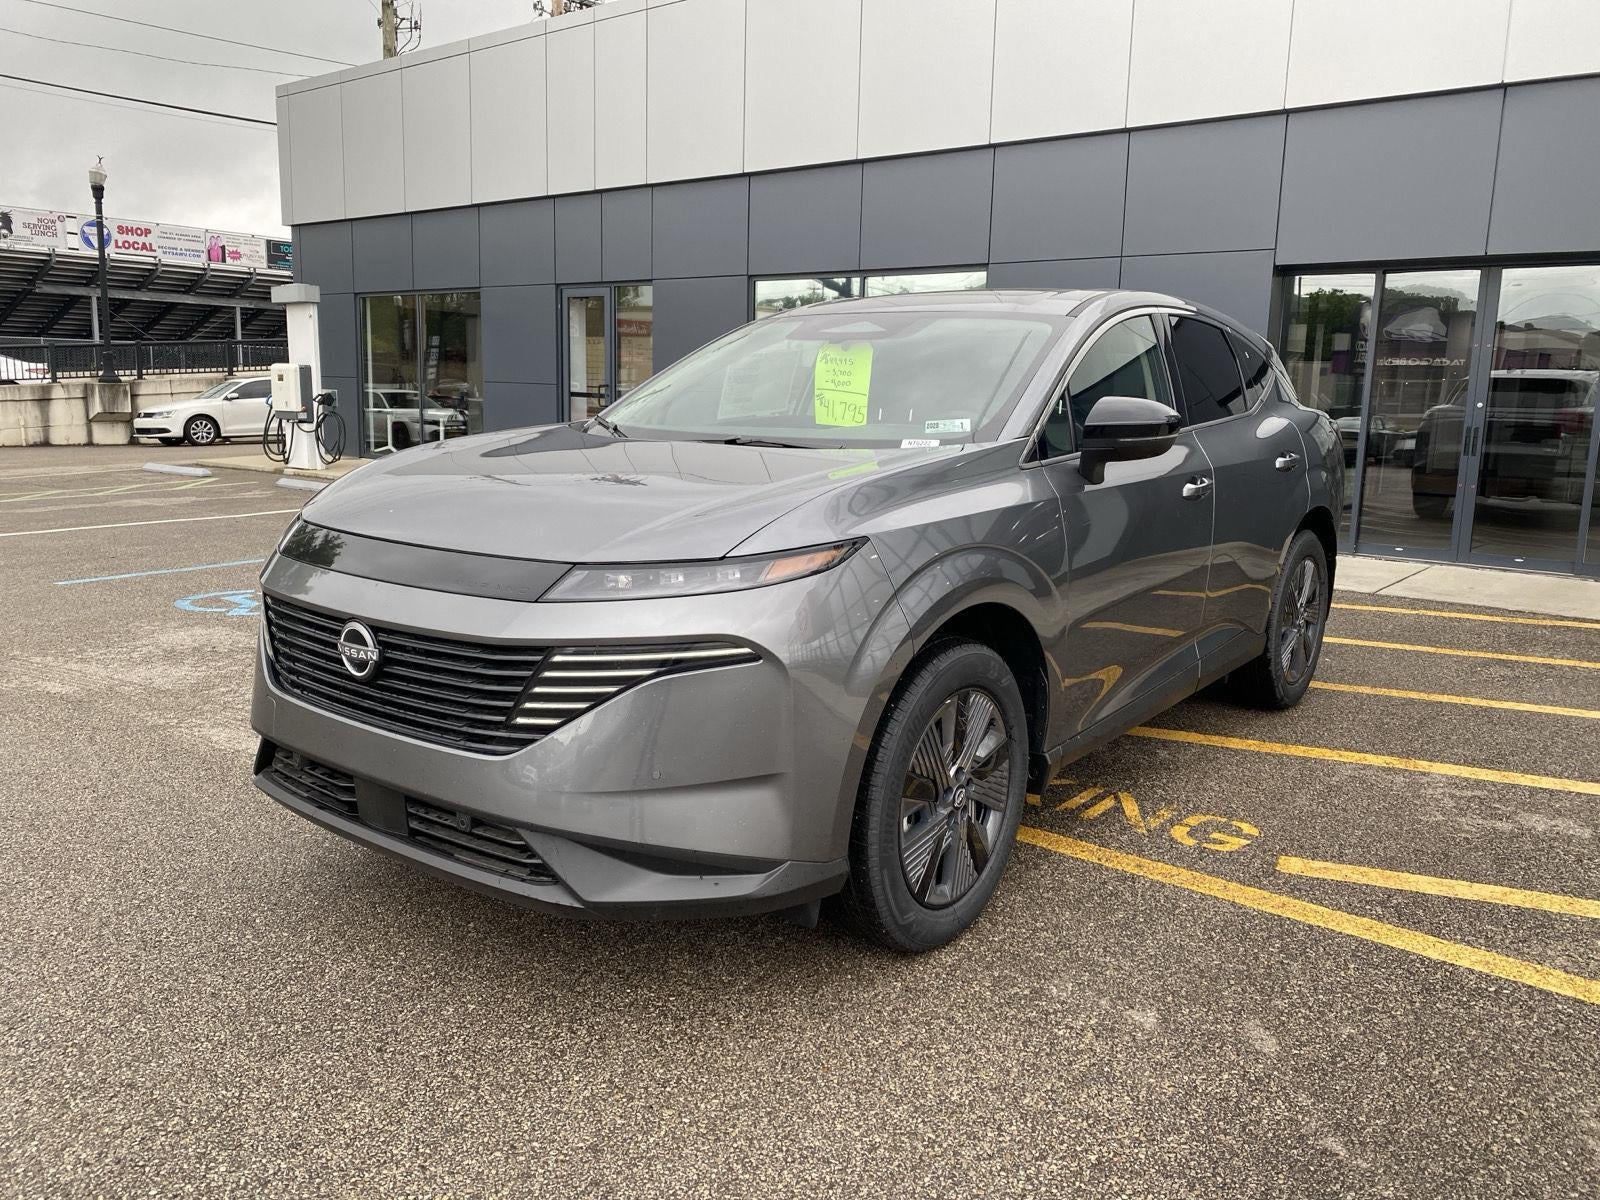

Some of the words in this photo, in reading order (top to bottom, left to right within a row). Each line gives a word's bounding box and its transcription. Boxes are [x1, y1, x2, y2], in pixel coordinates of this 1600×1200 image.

[22, 222, 57, 231] SERVING
[37, 217, 57, 225] NOW
[30, 229, 58, 238] LUNCH
[116, 224, 152, 238] SHOP
[114, 239, 157, 253] LOCAL
[816, 391, 867, 424] $41,795
